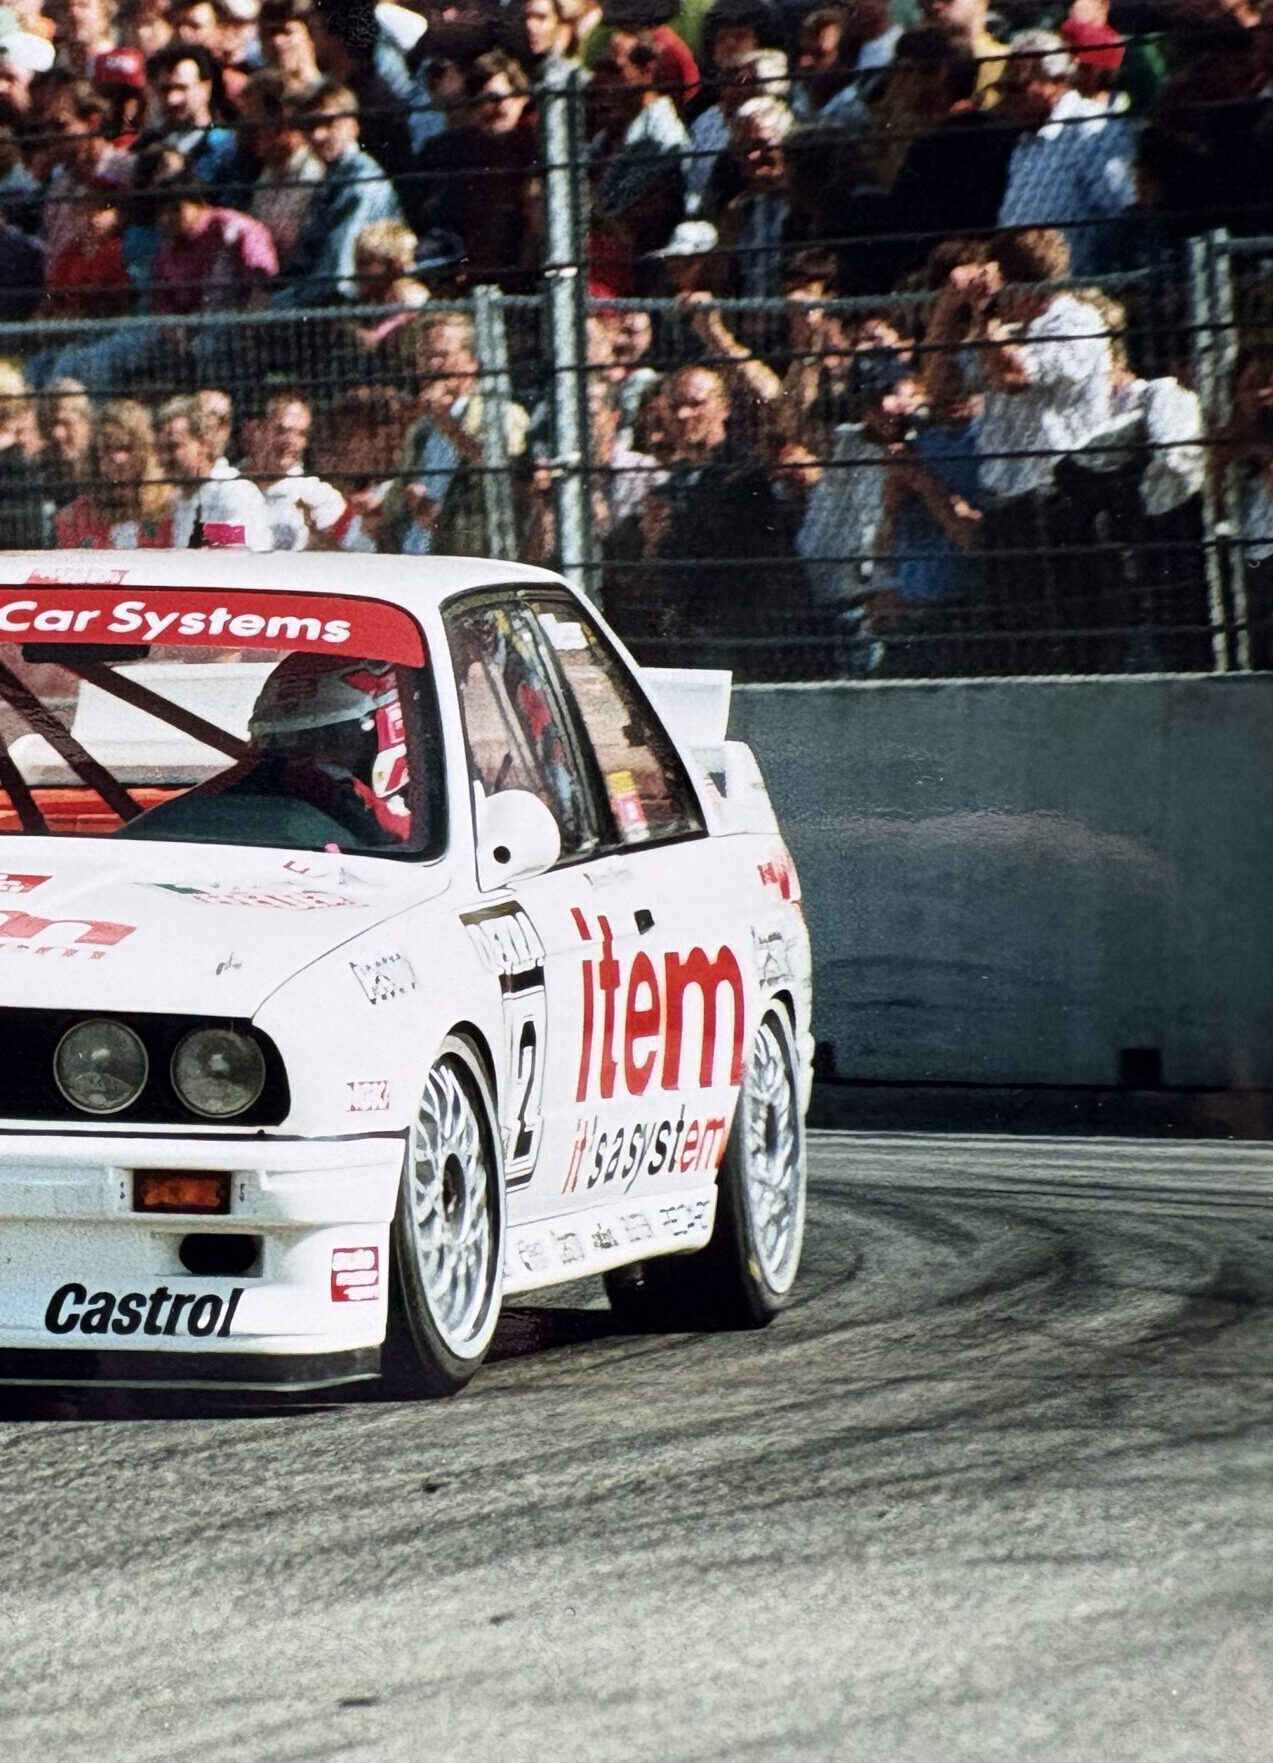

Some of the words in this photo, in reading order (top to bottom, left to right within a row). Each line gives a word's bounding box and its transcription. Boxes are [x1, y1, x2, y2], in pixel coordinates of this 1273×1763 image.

[108, 602, 352, 643] Systems
[570, 907, 745, 1102] item
[44, 1283, 244, 1338] Castrol
